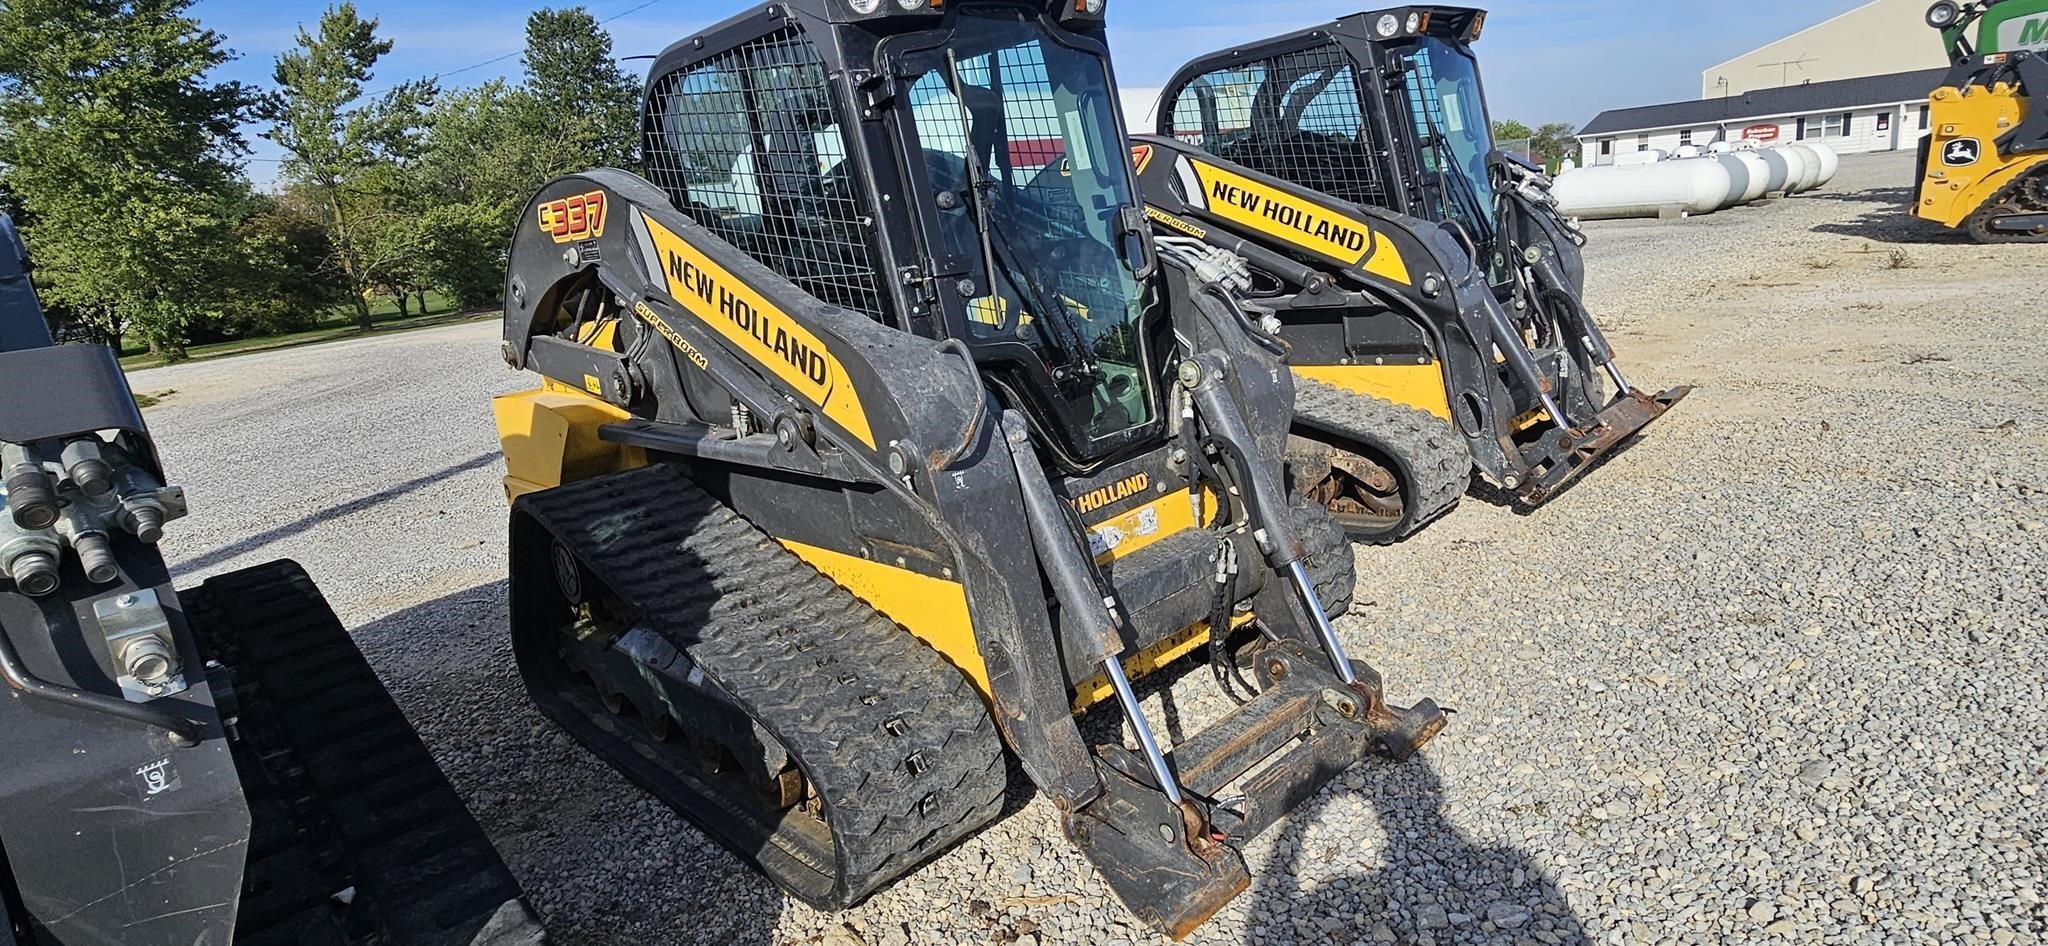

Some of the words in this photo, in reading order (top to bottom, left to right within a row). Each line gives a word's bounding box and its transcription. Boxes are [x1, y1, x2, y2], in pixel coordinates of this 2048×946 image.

[538, 190, 608, 244] C337
[1212, 180, 1260, 213] NEW
[1262, 199, 1365, 252] HOLLAND
[669, 250, 715, 306] NEW
[719, 286, 827, 387] HOLLAND
[1078, 471, 1148, 514] HOLLAND
